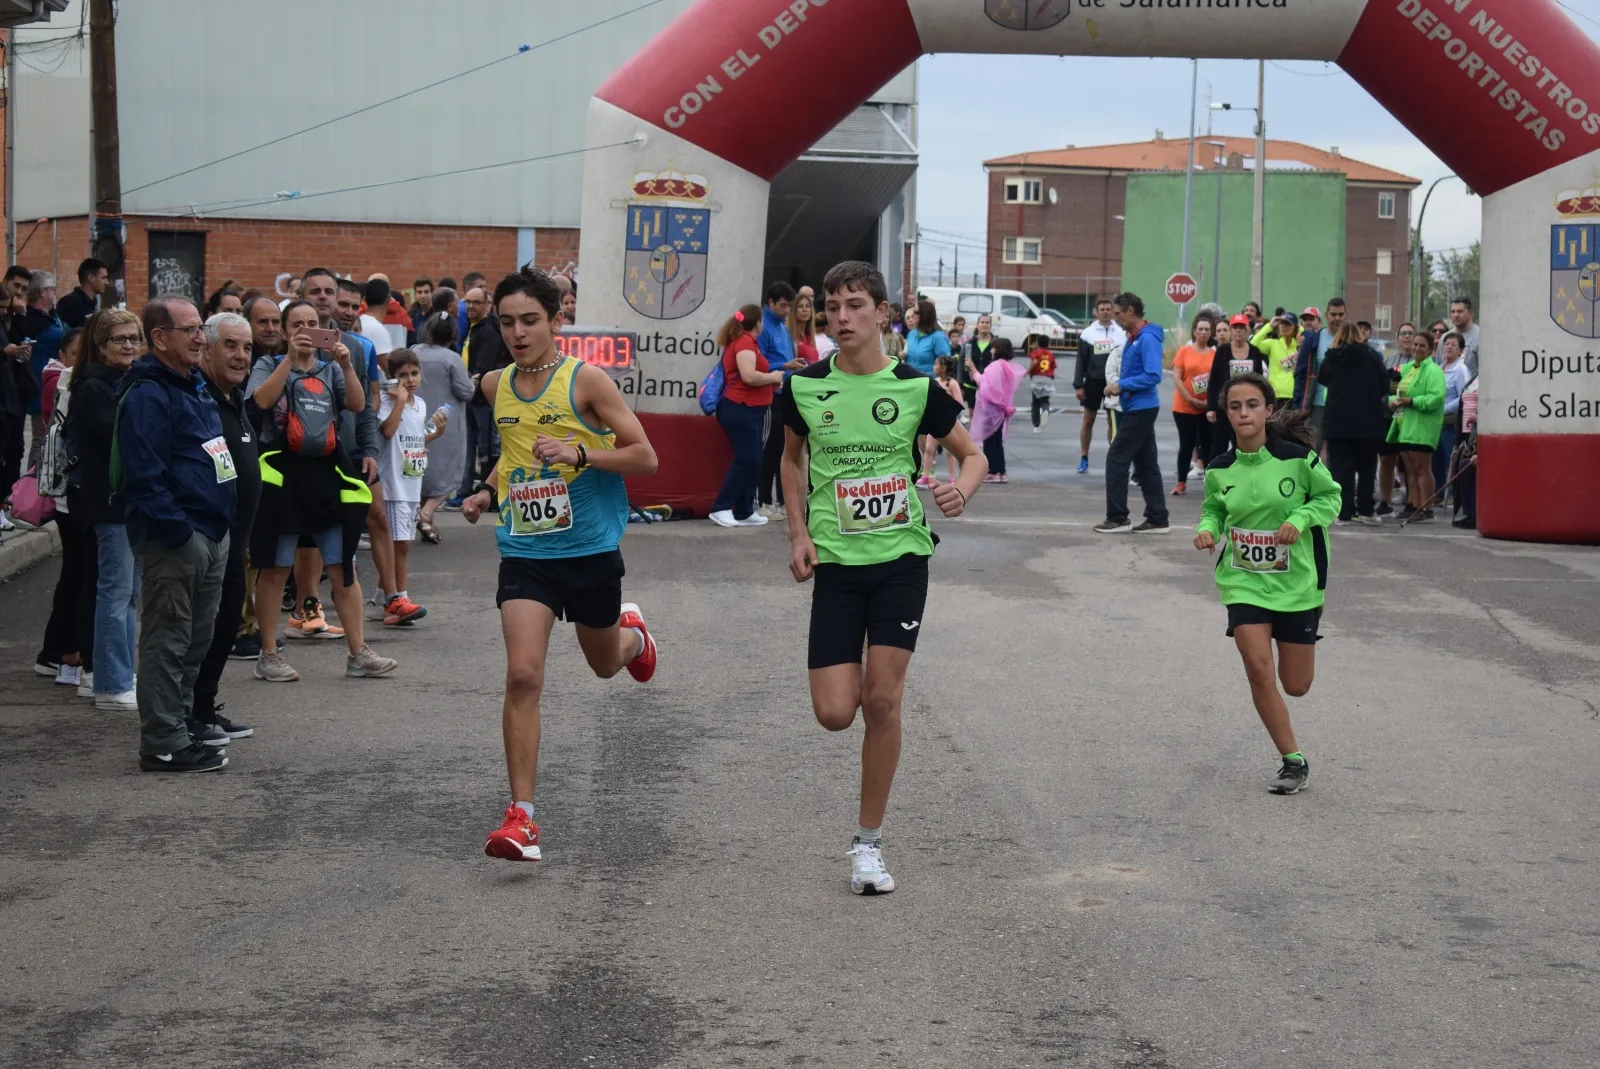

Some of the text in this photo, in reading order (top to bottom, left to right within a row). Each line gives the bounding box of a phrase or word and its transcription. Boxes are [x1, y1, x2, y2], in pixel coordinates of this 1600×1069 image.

[1396, 0, 1566, 151] DEPORTISTAS
[1468, 9, 1600, 135] NUESTROS
[663, 75, 723, 129] CON
[720, 48, 760, 80] EL
[1168, 283, 1195, 295] STOP
[1508, 399, 1528, 418] de
[509, 482, 567, 502] bedunia
[837, 477, 907, 499] bedunia
[520, 499, 557, 522] 206
[852, 494, 896, 521] 207
[1240, 544, 1277, 562] 208
